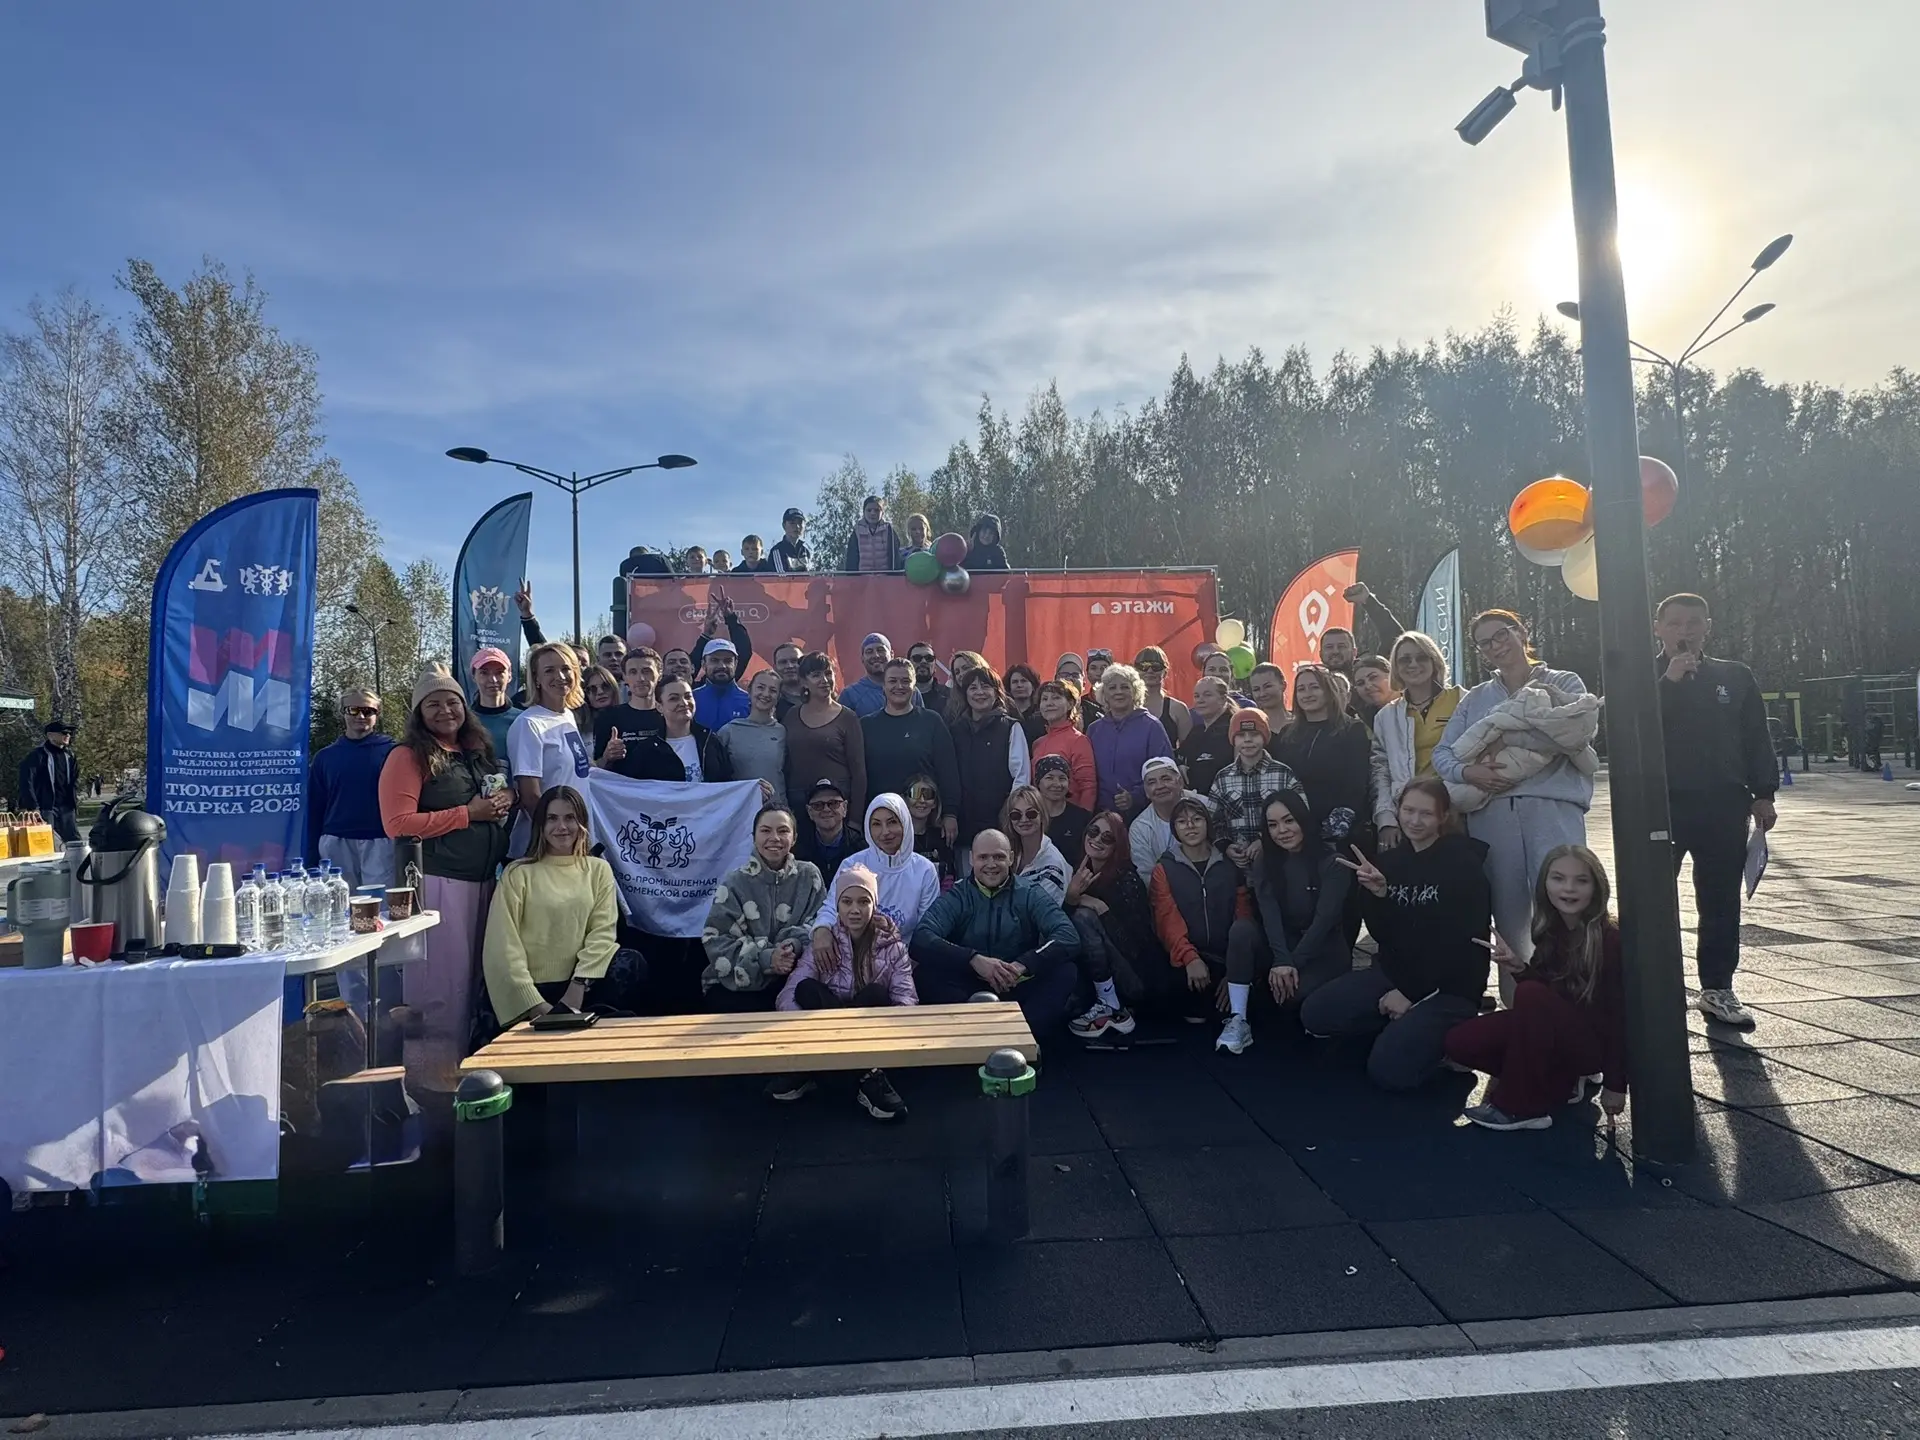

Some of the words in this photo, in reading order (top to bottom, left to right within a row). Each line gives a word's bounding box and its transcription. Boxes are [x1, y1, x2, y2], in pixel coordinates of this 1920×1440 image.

[1110, 600, 1174, 614] этажи
[1435, 587, 1450, 672] ОССИИ
[171, 749, 236, 759] ВЫСТАВКА
[238, 749, 301, 759] СУБЪЕКТОВ
[178, 758, 228, 768] МАЛОГО
[229, 760, 238, 768] И
[240, 758, 296, 768] СРЕДНЕГО
[165, 782, 301, 798] ТЮМЕНСКАЯ
[165, 799, 246, 815] МАРКА
[250, 797, 300, 814] 2026
[617, 872, 718, 888] ВО-ПРОМЫШЛЕННАЯ
[682, 888, 717, 898] ОБЛАСТ
